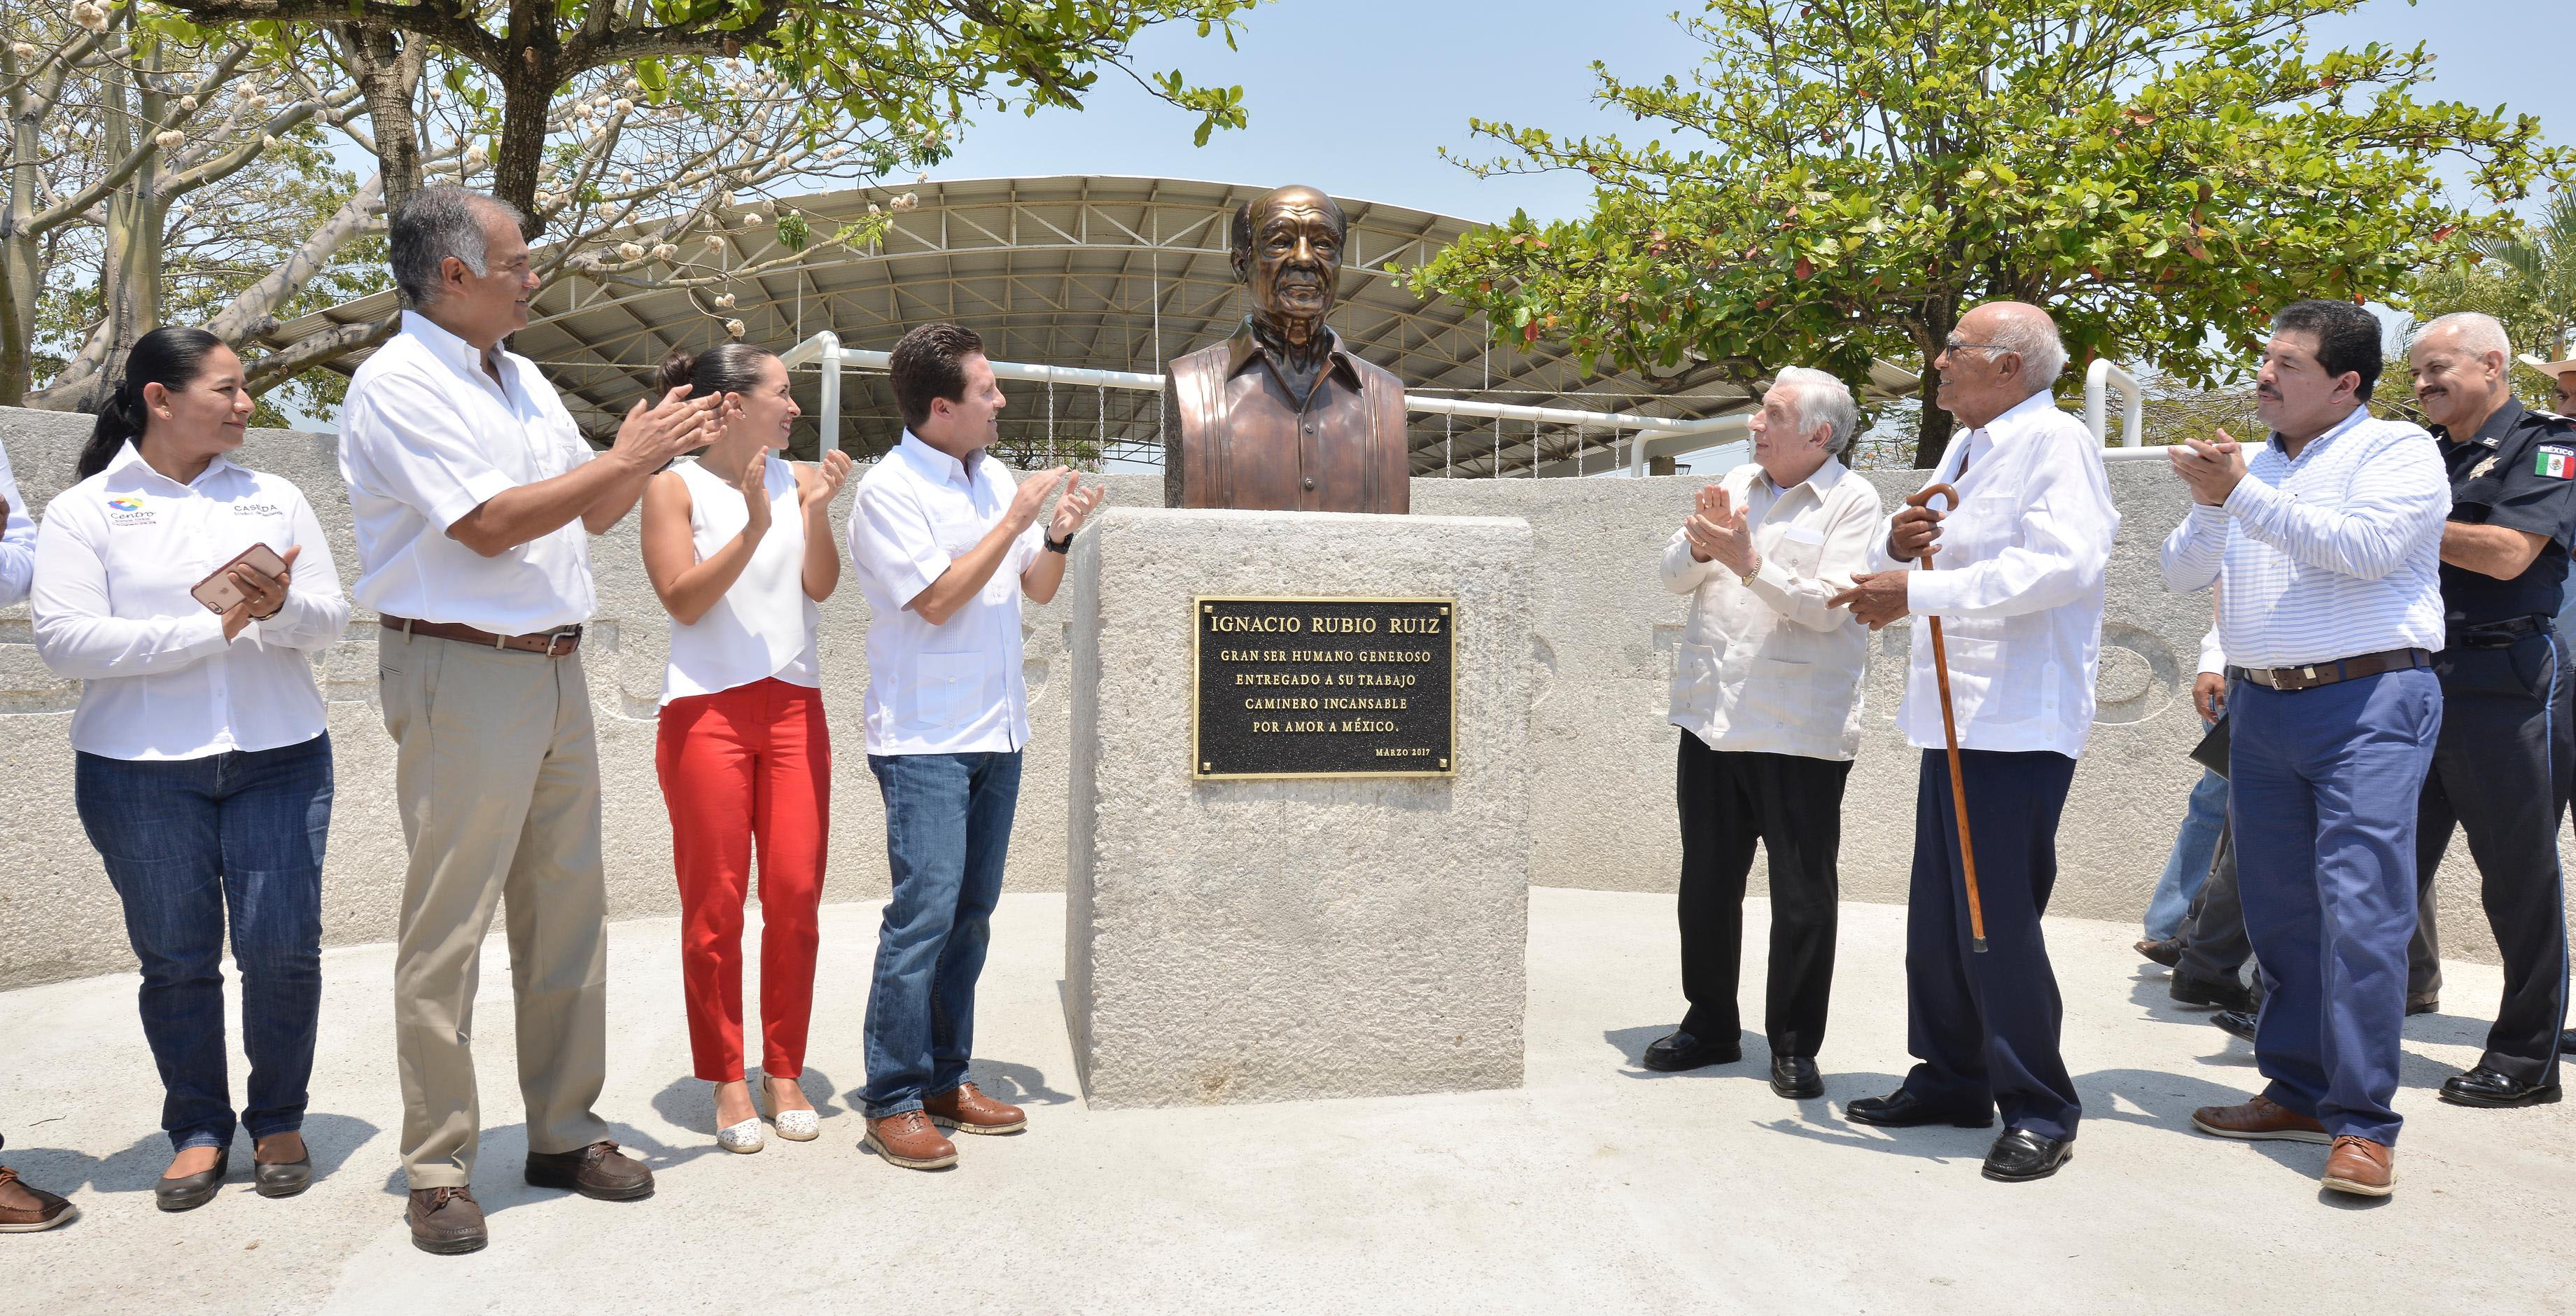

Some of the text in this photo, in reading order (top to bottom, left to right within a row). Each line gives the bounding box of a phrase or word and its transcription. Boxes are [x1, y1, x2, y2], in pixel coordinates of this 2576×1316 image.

[2539, 445, 2574, 456] MÉXICO
[1211, 616, 1440, 634] IGNACIO RUBIO RUIZ
[1221, 650, 1431, 662] GRAN SER HUMANO GENEROSO
[1235, 673, 1415, 688] ENTREGADO A SU TRABAJO
[1245, 697, 1407, 709] CAMINERO INCANSABLE
[1253, 717, 1399, 732] POR AMOR A MÉXICO.
[1376, 748, 1430, 757] MARZO 2017
